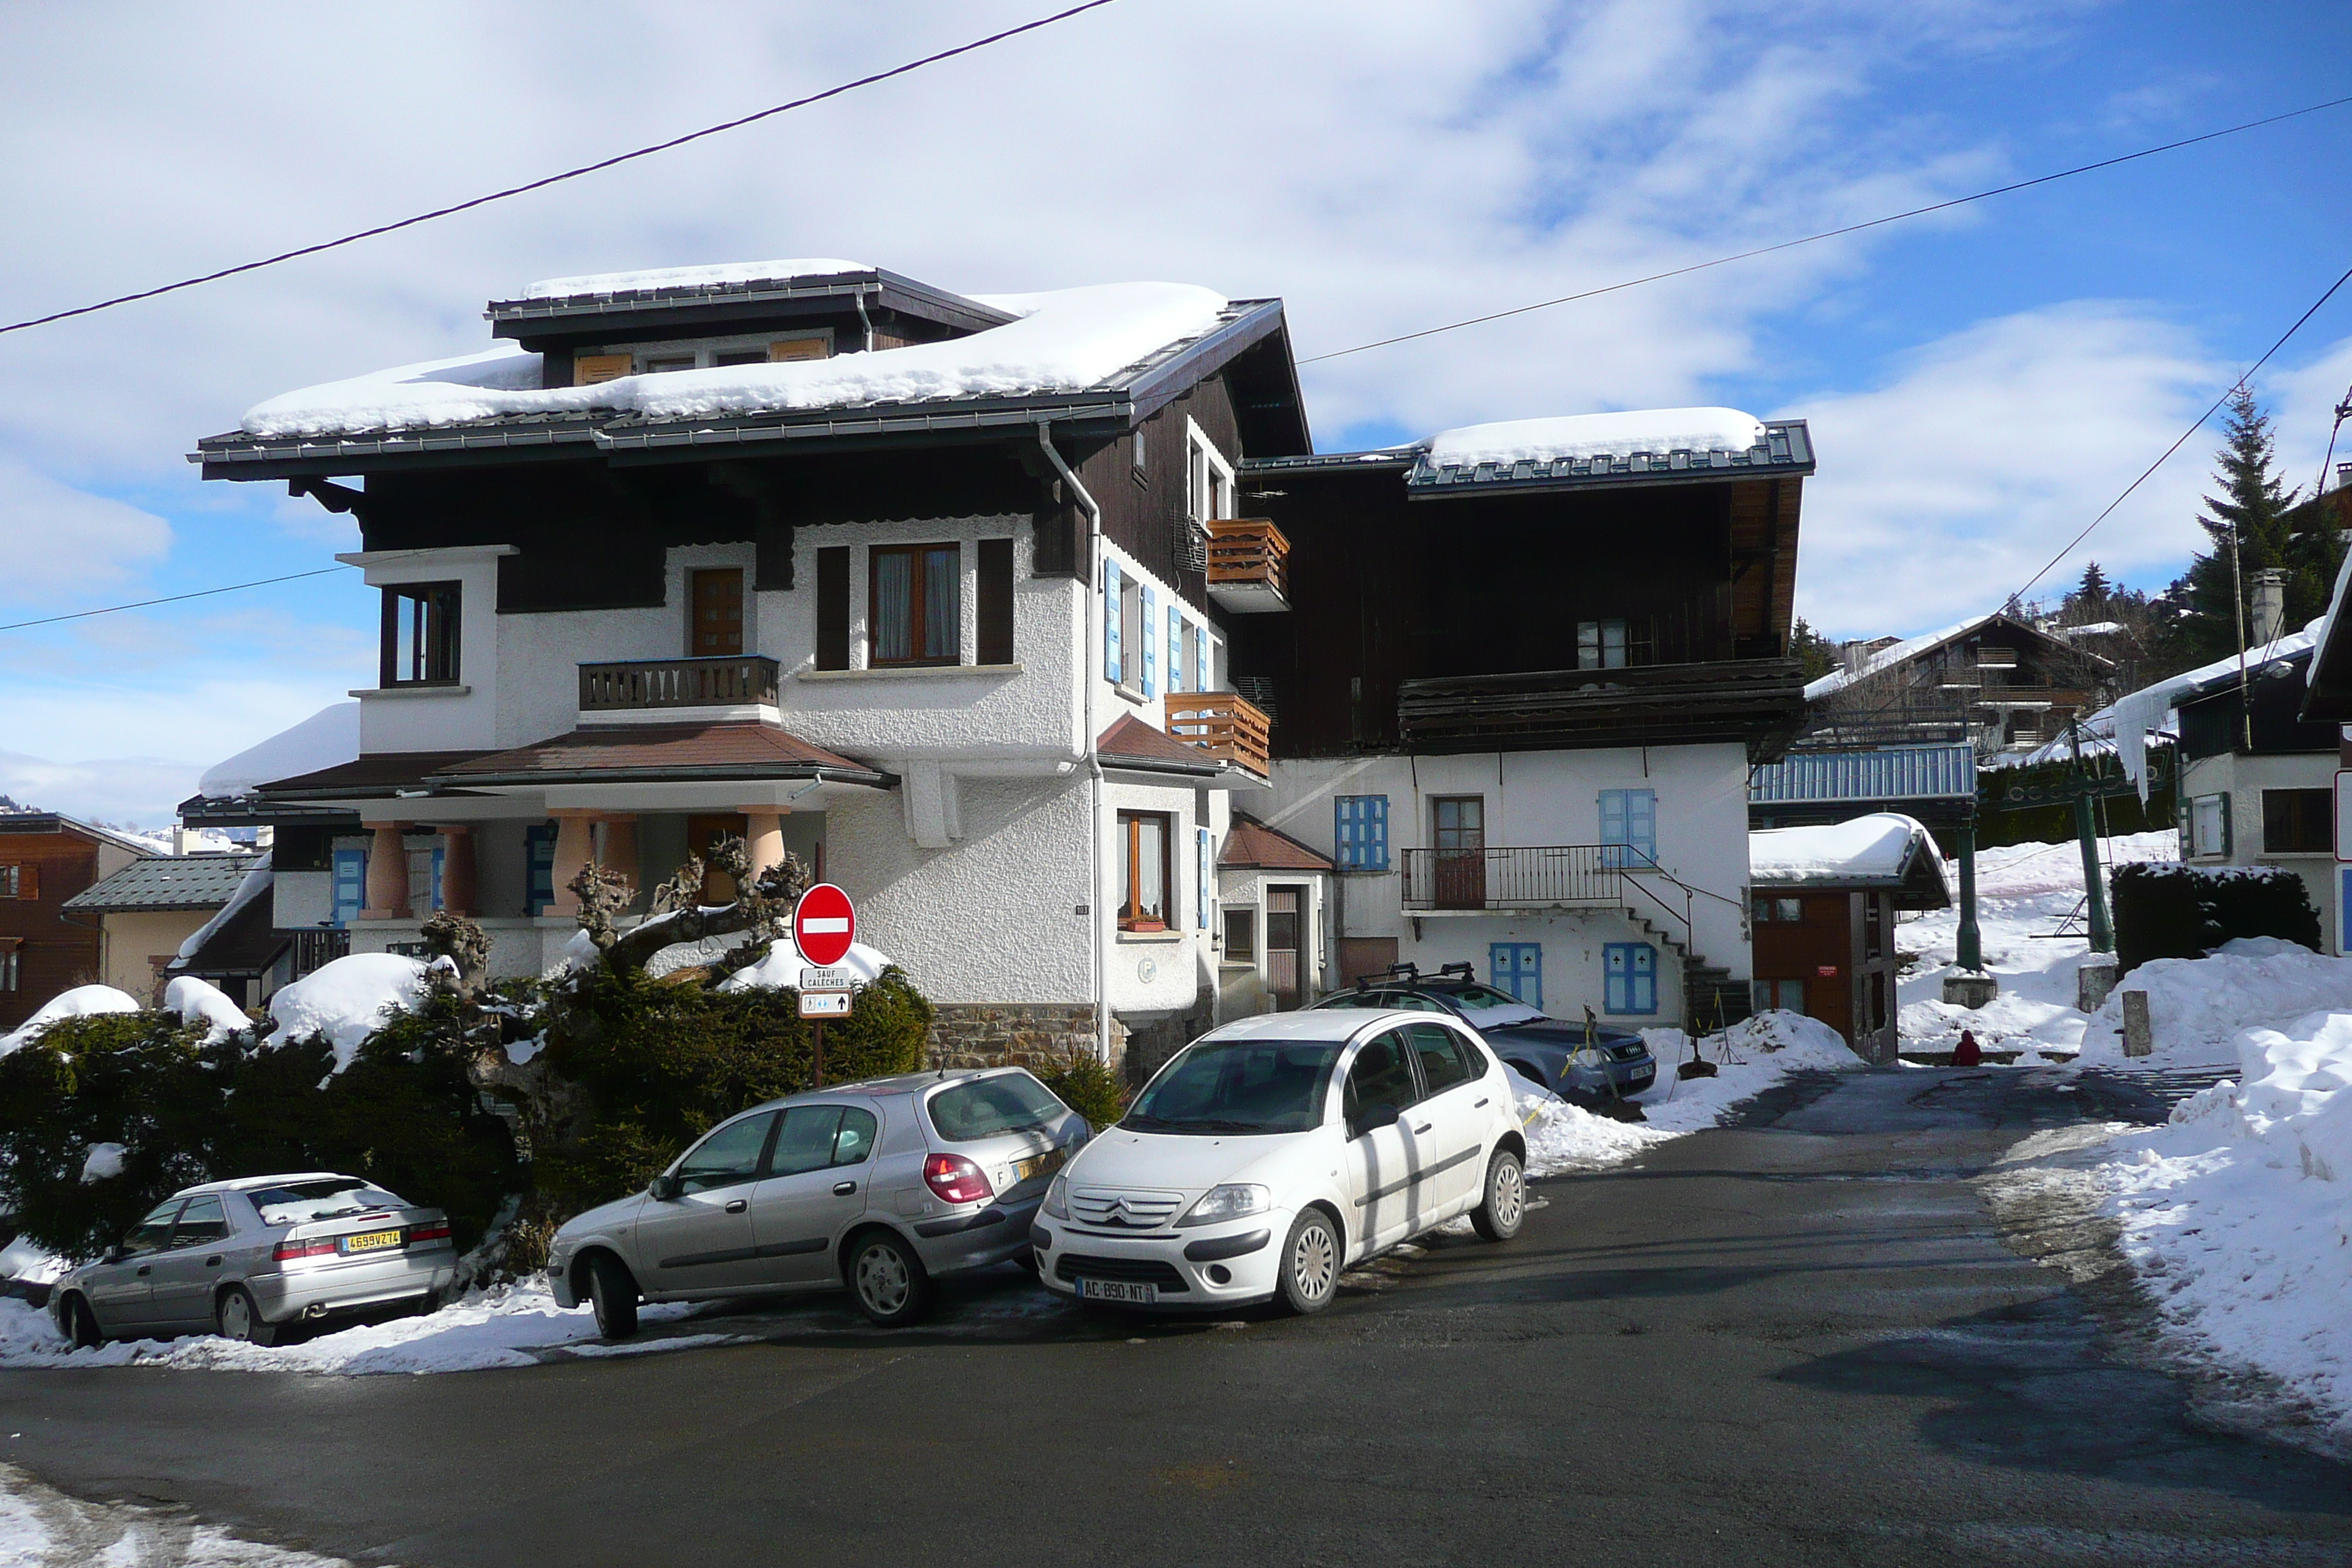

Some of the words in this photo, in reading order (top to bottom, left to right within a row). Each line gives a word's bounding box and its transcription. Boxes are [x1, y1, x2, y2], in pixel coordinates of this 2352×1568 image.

[1077, 906, 1088, 914] 103
[1144, 961, 1152, 973] P
[817, 970, 836, 978] SAUF
[998, 1171, 1003, 1186] F
